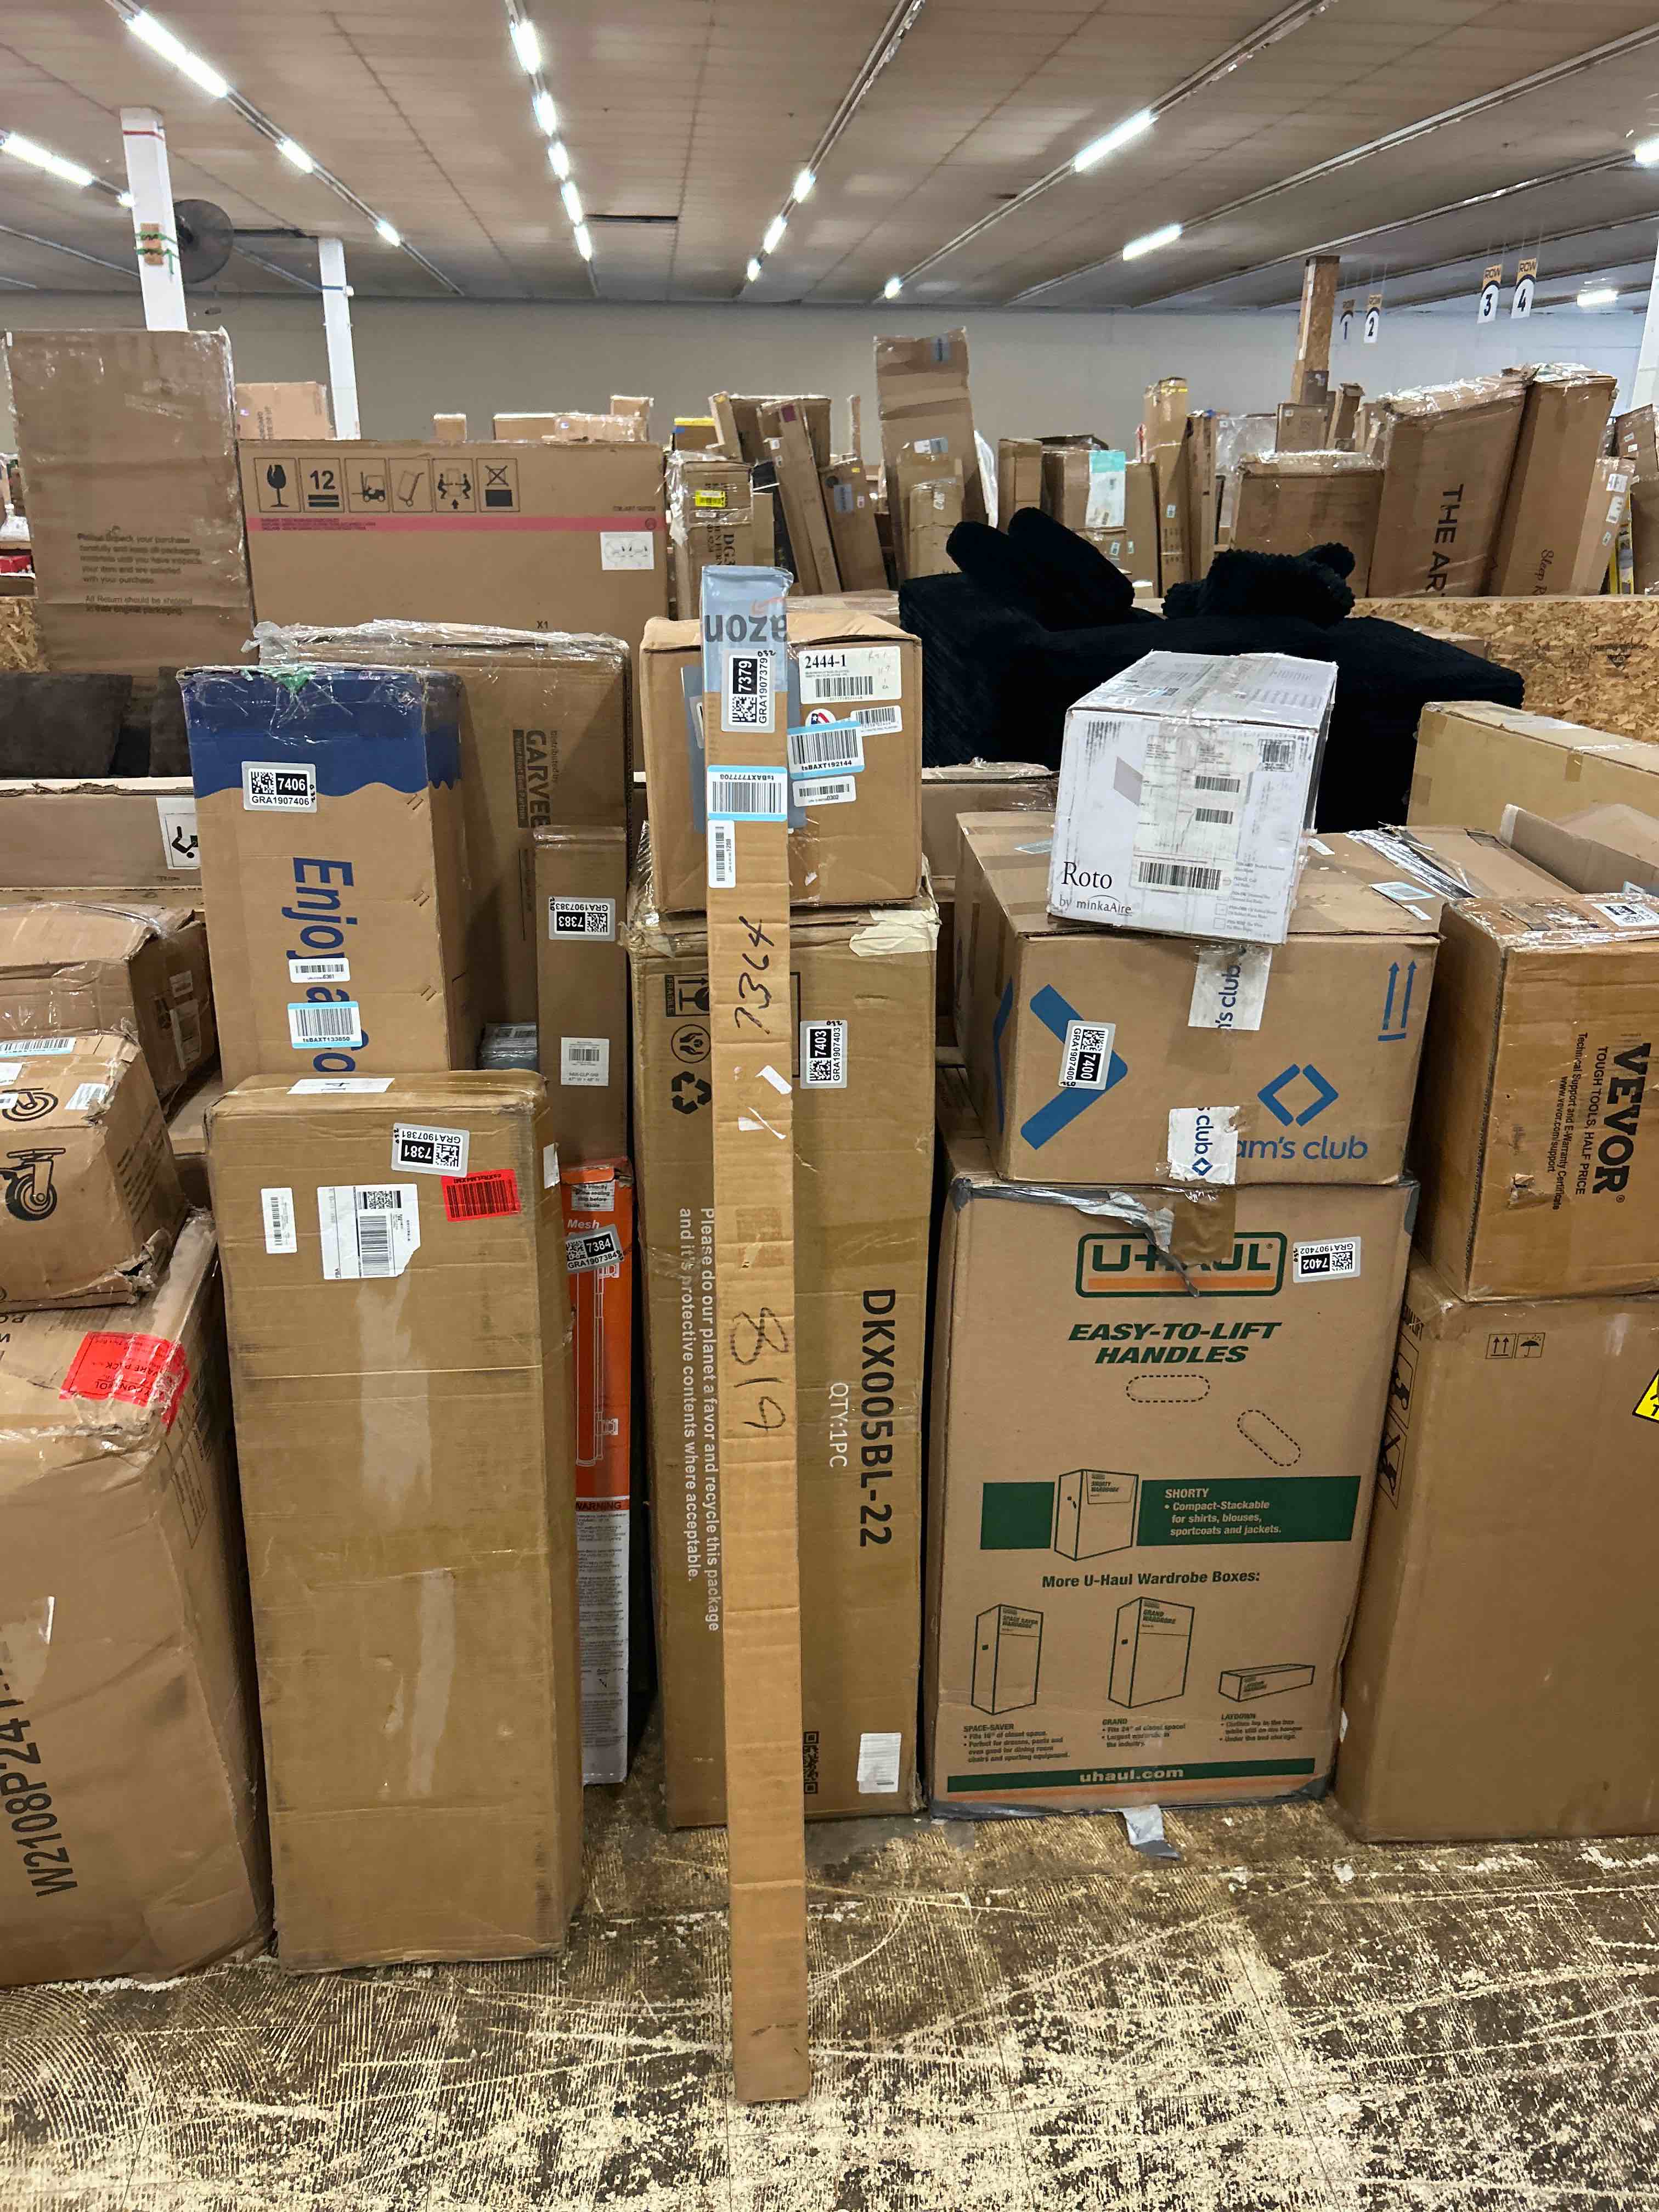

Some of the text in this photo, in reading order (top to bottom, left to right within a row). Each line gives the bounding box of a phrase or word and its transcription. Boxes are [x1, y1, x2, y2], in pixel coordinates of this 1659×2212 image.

[1485, 267, 1501, 279] ROW
[1519, 261, 1536, 273] ROW
[1483, 294, 1493, 317] 3
[1517, 289, 1526, 312] 4
[1344, 321, 1347, 340] 1
[1368, 317, 1374, 337] 2
[310, 470, 336, 490] 12
[1425, 483, 1464, 596] THE AR
[1534, 549, 1554, 581] Sleep
[805, 654, 848, 669] 2444-1
[738, 660, 752, 692] 7379
[759, 658, 768, 724] GRA1907379
[801, 759, 852, 771] tsBAXT192144
[277, 777, 306, 792] 7406
[526, 730, 552, 827] GARVEE
[252, 795, 309, 805] GRA1907406
[1061, 861, 1112, 889] Roto
[556, 903, 608, 911] GRA1907383
[1059, 894, 1132, 915] by minkaAire
[558, 916, 584, 927] 7383
[734, 916, 775, 1035] 7364
[1218, 964, 1243, 1008] club
[815, 1030, 827, 1057] 7403
[832, 1027, 840, 1081] GRA1907403
[1066, 1028, 1081, 1080] GRA1907400
[1080, 1054, 1096, 1079] 7400
[1548, 1076, 1568, 1173] www.vevor.com/support
[1552, 1032, 1588, 1210] Technical Support and E-Warranty Certificate
[1576, 1046, 1609, 1195] TOUGH TOOLS, HALF PRICE
[1592, 1042, 1651, 1194] VEVOR
[402, 1130, 461, 1144] GRA1907381
[1194, 1115, 1215, 1154] club
[404, 1144, 432, 1160] 7381
[1237, 1135, 1368, 1159] am's club
[567, 1219, 600, 1229] Mesh
[586, 1238, 612, 1253] 7384
[1300, 1242, 1353, 1254] GRA1907402
[568, 1251, 617, 1269] GRA1907384
[1303, 1257, 1329, 1271] 7402
[1068, 1322, 1283, 1341] EASY-TO-LIFT
[1094, 1345, 1249, 1364] HANDLES
[680, 1209, 702, 1582] and it's protective contents where acceptable.
[699, 1208, 721, 1631] Please do our planet a favor and recycle this package
[828, 1382, 849, 1468] QTY:1PC
[860, 1289, 896, 1547] DKX005BL-22
[1165, 1487, 1210, 1498] SHORTY
[1172, 1500, 1270, 1511] Compact-Stackable
[1171, 1514, 1262, 1523] for shirts, blouses,
[1170, 1525, 1282, 1537] sportcoats and jackets.
[1042, 1570, 1261, 1589] More U-Haul Wardrobe Boxes:
[963, 1723, 1014, 1733] SPACE-SAVER
[1079, 1766, 1185, 1784] uhaul.com
